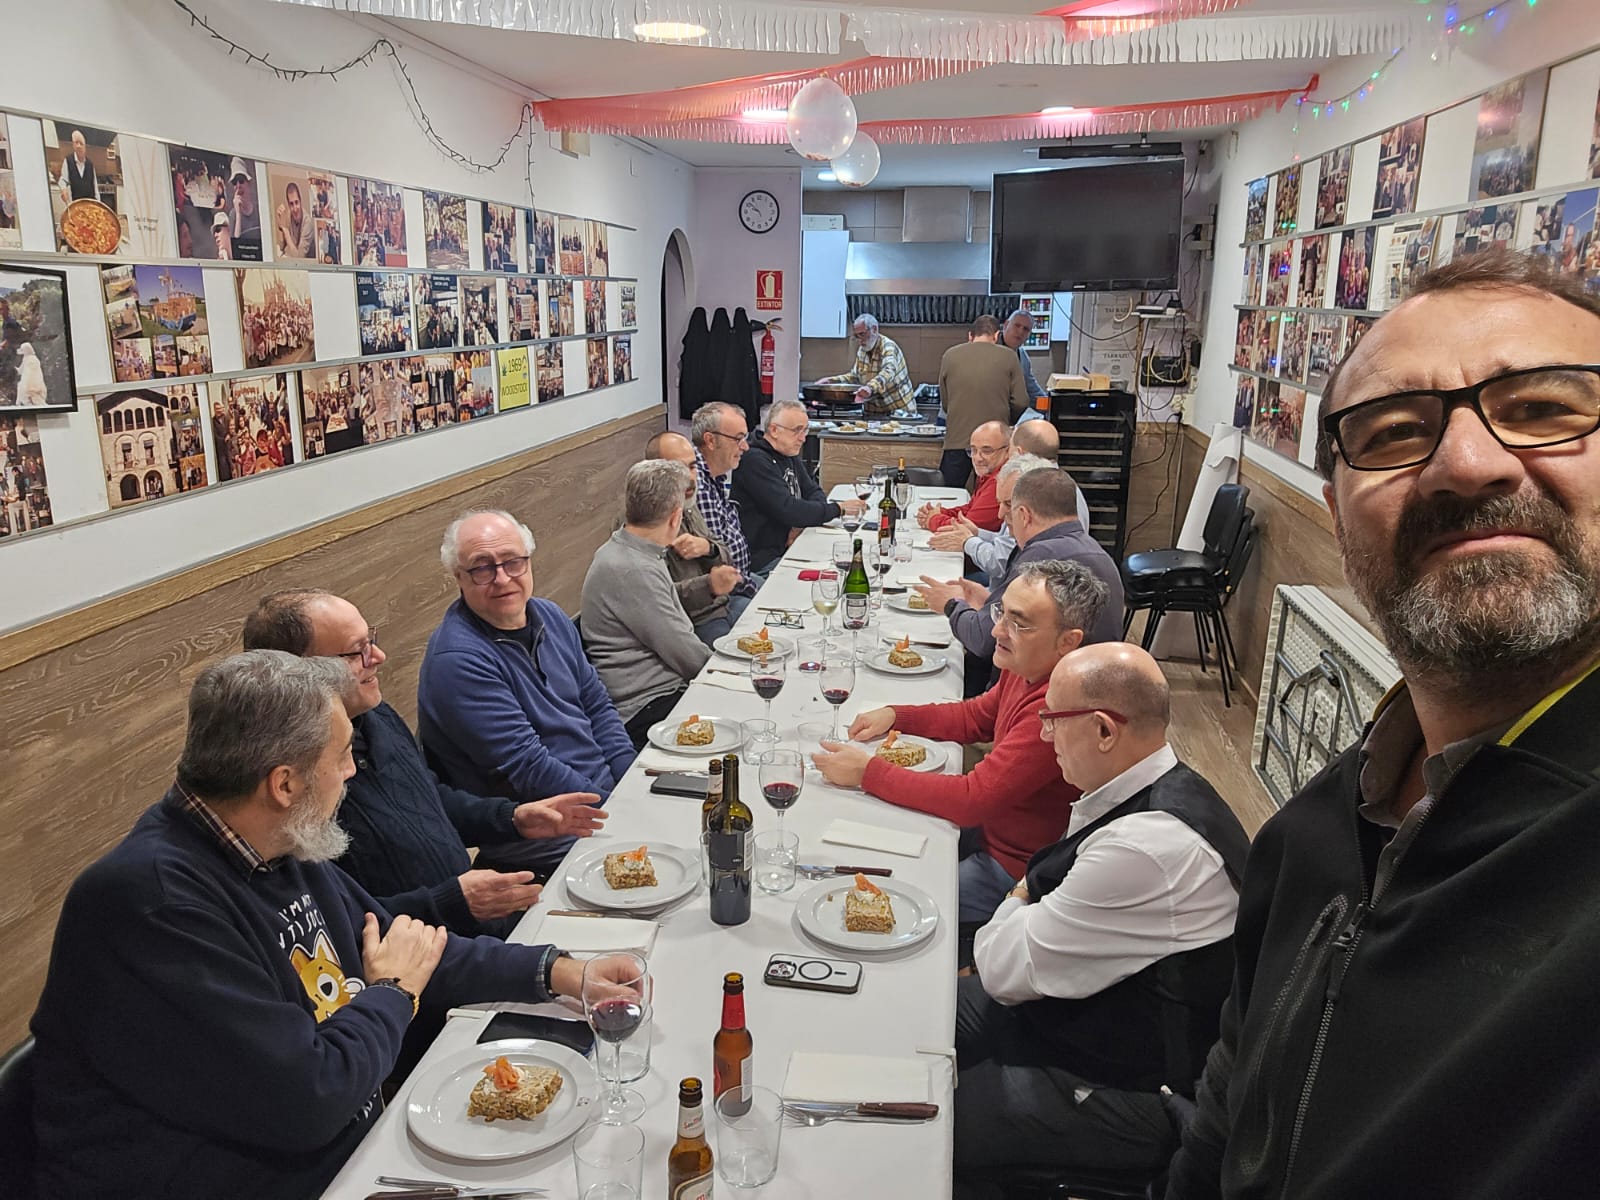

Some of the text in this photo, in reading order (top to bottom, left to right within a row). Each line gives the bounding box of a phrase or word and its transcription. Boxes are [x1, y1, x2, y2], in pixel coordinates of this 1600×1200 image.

[757, 300, 782, 308] EXTINTOR
[507, 357, 522, 373] 1969
[501, 382, 528, 397] WOODSTOCK
